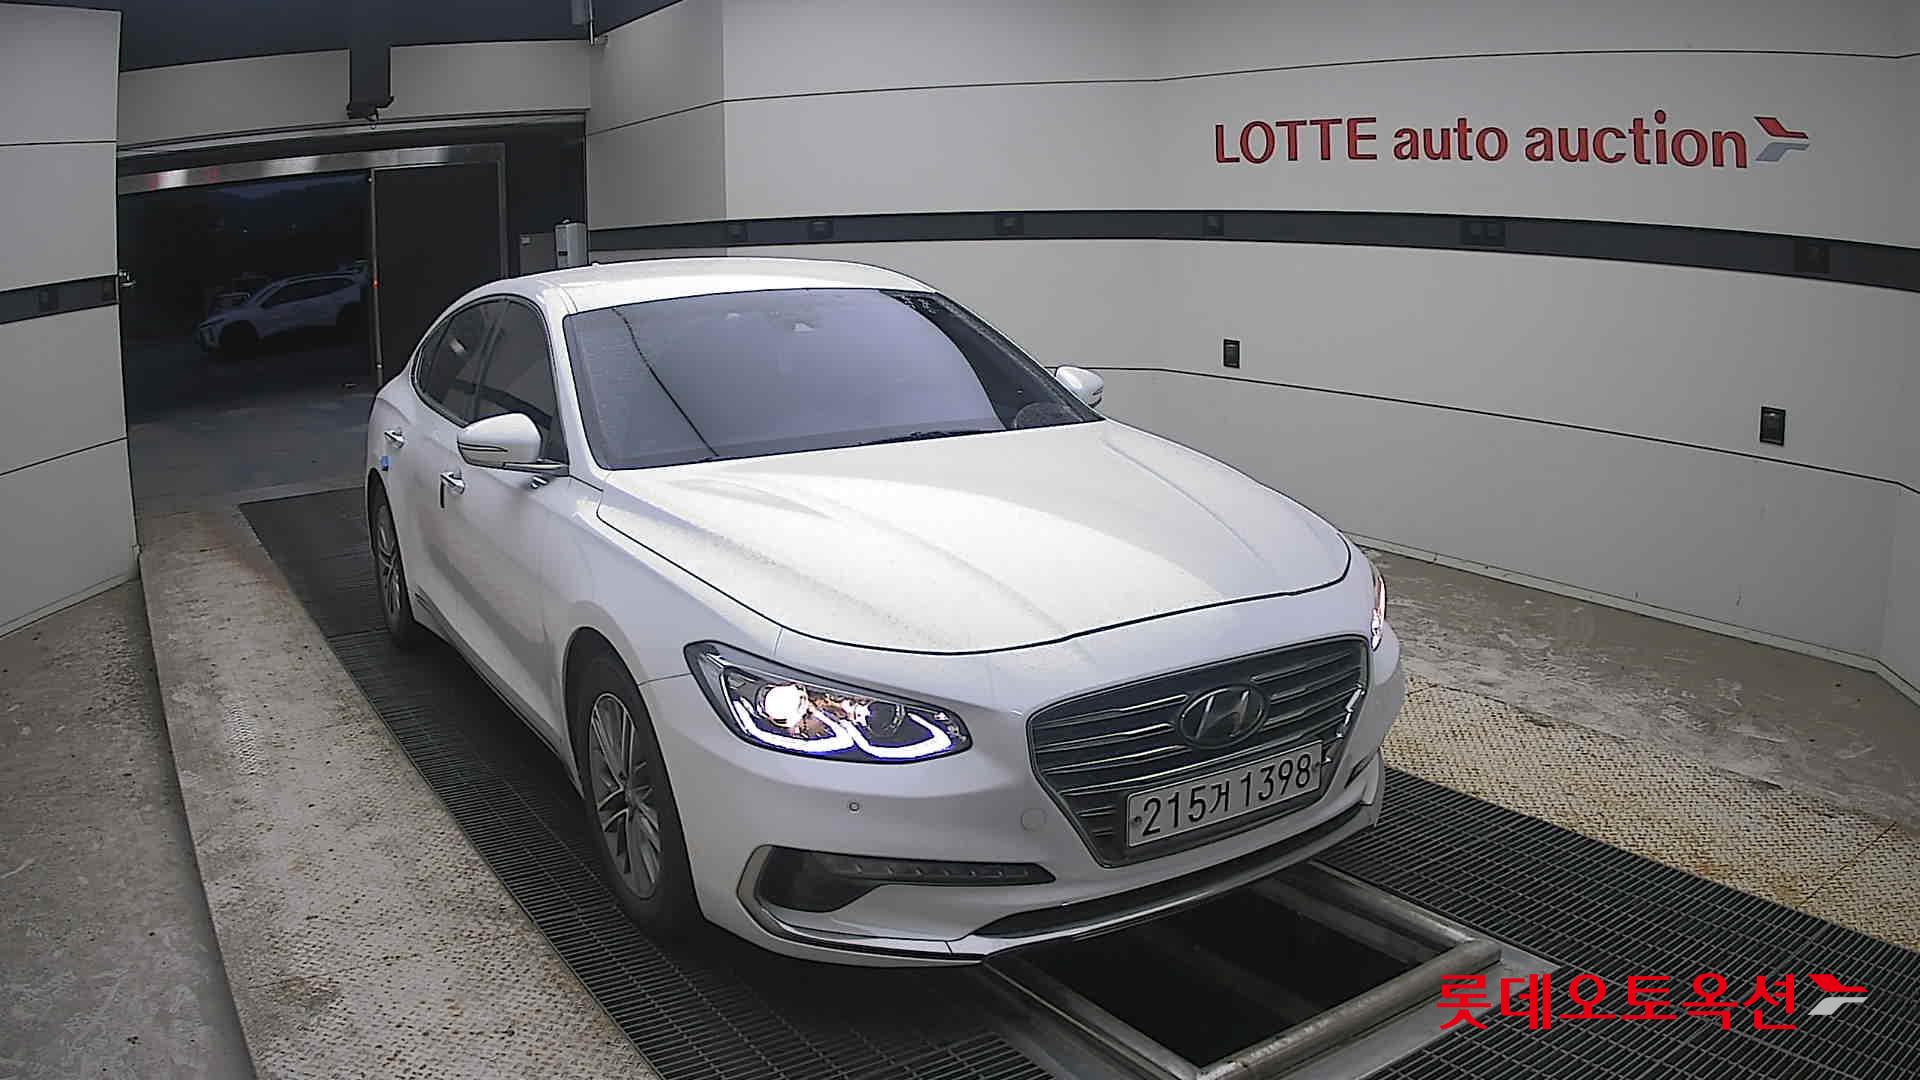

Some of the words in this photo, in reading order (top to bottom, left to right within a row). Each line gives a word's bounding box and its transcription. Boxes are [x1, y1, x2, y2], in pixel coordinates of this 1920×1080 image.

[1215, 117, 1377, 164] LOTTE
[1393, 117, 1509, 161] auto
[1524, 109, 1748, 169] auction
[1142, 781, 1230, 837] 215거
[1240, 753, 1312, 807] 1398
